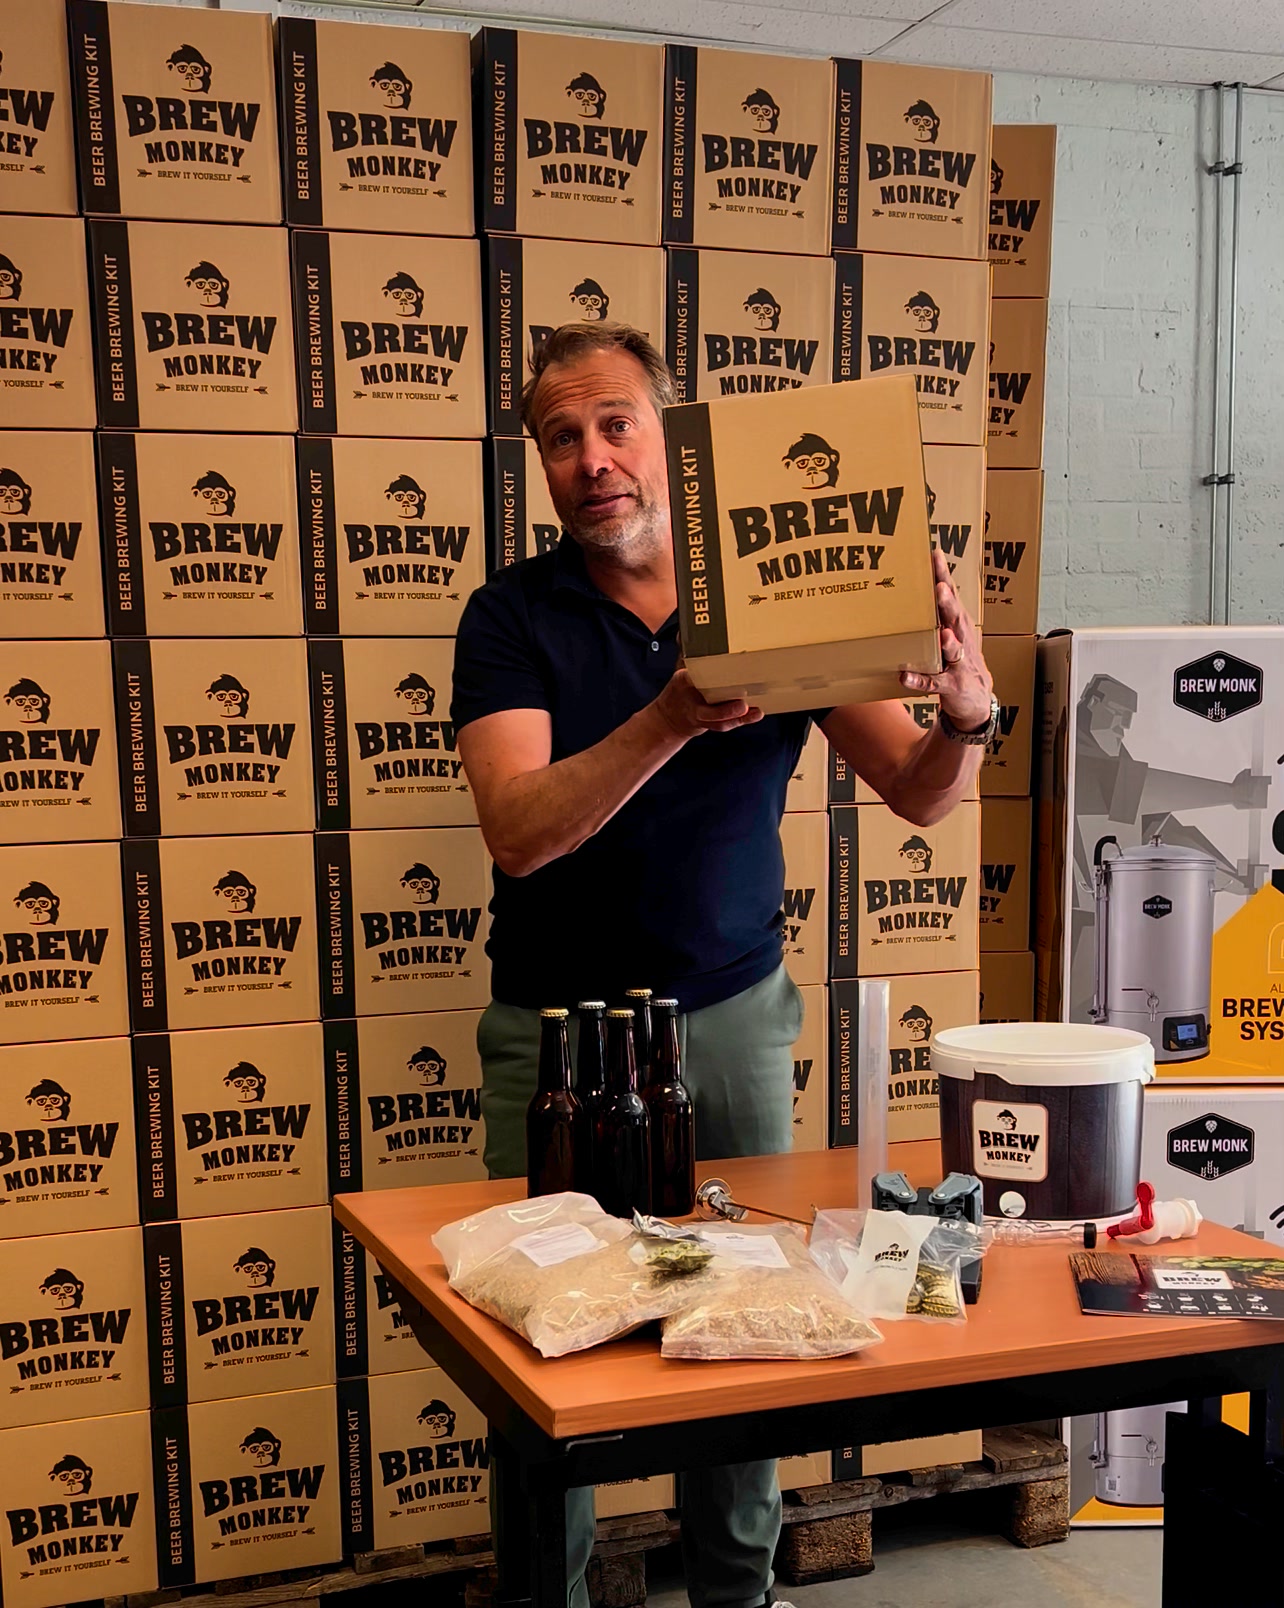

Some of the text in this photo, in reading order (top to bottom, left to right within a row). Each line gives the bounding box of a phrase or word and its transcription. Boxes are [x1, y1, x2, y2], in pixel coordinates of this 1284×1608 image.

[85, 34, 105, 186] BEER BREWING KIT
[122, 95, 261, 142] BREW
[293, 51, 309, 199] BEER BREWING KIT
[327, 111, 457, 158] BREW
[494, 60, 506, 204] BEER BREWING KIT
[524, 119, 648, 167] BREW
[673, 77, 685, 217] BEER BREWING KIT
[144, 140, 244, 167] MONKEY
[347, 155, 441, 182] MONKEY
[702, 134, 818, 180] BREW
[838, 89, 850, 223] BEER BREWING KIT
[866, 143, 976, 188] BREW
[157, 171, 180, 179] BREW
[193, 172, 232, 181] YOURSELF
[541, 163, 630, 190] MONKEY
[551, 191, 571, 200] BREW
[582, 194, 617, 203] YOURSELF
[717, 177, 801, 204] MONKEY
[726, 205, 745, 213] BREW
[756, 207, 788, 216] YOURSELF
[880, 185, 960, 210] MONKEY
[105, 254, 124, 401] BEER BREWING KIT
[141, 312, 277, 354] BREW
[307, 264, 324, 408] BEER BREWING KIT
[340, 321, 469, 363] BREW
[163, 355, 261, 379] MONKEY
[360, 363, 452, 387] MONKEY
[113, 466, 132, 610] BEER BREWING KIT
[148, 522, 283, 562] BREW
[311, 469, 326, 609] BEER BREWING KIT
[343, 524, 470, 563] BREW
[682, 446, 709, 624] BEER BREWING KIT
[728, 487, 904, 559] BREW
[170, 562, 267, 586] MONKEY
[363, 564, 454, 587] MONKEY
[757, 545, 884, 586] MONKEY
[774, 581, 869, 601] BREW IT YOURSELF
[1180, 679, 1256, 692] BREW MONK
[128, 672, 146, 812] BEER BREWING KIT
[163, 723, 296, 765] BREW
[184, 763, 280, 787] MONKEY
[840, 835, 849, 955] BEER BREWING KIT
[864, 876, 967, 914] BREW
[137, 872, 154, 1007] BEER BREWING KIT
[171, 916, 302, 960] BREW
[329, 864, 343, 994] BEER BREWING KIT
[360, 907, 482, 949] BREW
[878, 912, 952, 934] MONKEY
[192, 957, 286, 982] MONKEY
[378, 946, 466, 970] MONKEY
[420, 971, 454, 979] YOURSELF
[204, 985, 225, 993] BREW
[237, 982, 274, 991] YOURSELF
[841, 1008, 850, 1125] BEER BREWING KIT
[182, 1104, 311, 1151] BREW
[337, 1050, 350, 1177] BEER BREWING KIT
[367, 1088, 482, 1132] BREW
[148, 1066, 164, 1197] BEER BREWING KIT
[386, 1126, 472, 1152] MONKEY
[978, 1130, 1040, 1152] BREW
[1173, 1138, 1248, 1152] BREW MONK
[3, 1164, 102, 1192] MONKEY
[202, 1144, 295, 1171] MONKEY
[986, 1151, 1031, 1164] MONKEY
[192, 1287, 319, 1337] BREW
[343, 1230, 356, 1356] BEER BREWING KIT
[0, 1309, 131, 1360] BREW
[159, 1255, 174, 1383] BEER BREWING KIT
[212, 1327, 303, 1356] MONKEY
[223, 1358, 244, 1366] BREW
[256, 1352, 291, 1362] YOURSELF
[17, 1350, 114, 1380] MONKEY
[348, 1409, 362, 1532] BEER BREWING KIT
[378, 1436, 490, 1487] BREW
[166, 1437, 182, 1564] BEER BREWING KIT
[199, 1465, 325, 1518] BREW
[396, 1475, 482, 1505] MONKEY
[6, 1492, 140, 1546] BREW
[218, 1505, 309, 1536] MONKEY
[27, 1534, 123, 1565] MONKEY
[40, 1566, 62, 1576] BREW
[74, 1559, 111, 1570] YOURSELF
